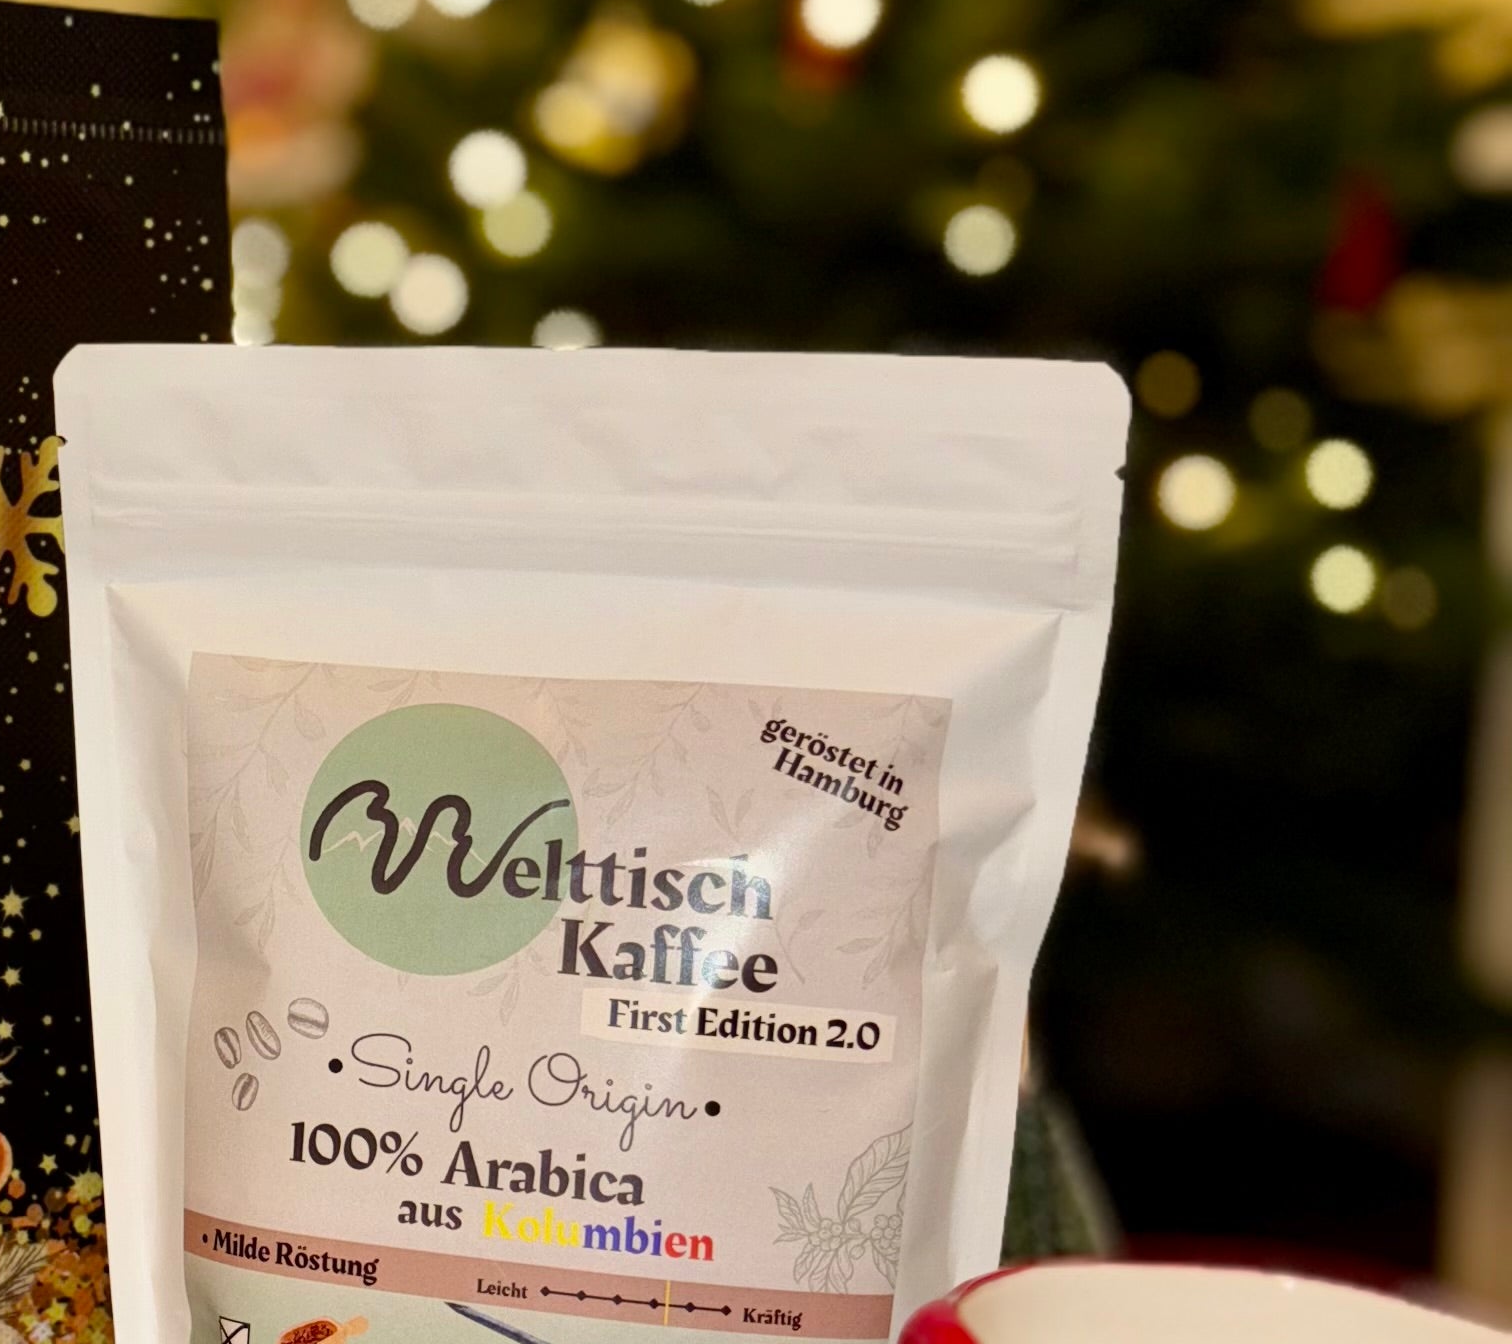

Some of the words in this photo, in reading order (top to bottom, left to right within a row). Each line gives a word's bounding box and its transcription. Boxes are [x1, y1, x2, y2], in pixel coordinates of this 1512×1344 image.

[760, 719, 879, 780] geröstet
[878, 765, 903, 795] in
[772, 746, 910, 831] Hamburg
[309, 778, 773, 921] Welttisch
[558, 918, 779, 993] Kaffee
[607, 998, 687, 1034] First
[696, 1006, 817, 1046] Edition
[825, 1019, 880, 1050] 2.0
[351, 1033, 514, 1132] Single
[528, 1052, 697, 1152] Origin
[289, 1121, 423, 1176] 100%
[440, 1140, 644, 1207] Arabica
[212, 1228, 270, 1263] Milde
[275, 1242, 380, 1286] Röstung
[397, 1200, 463, 1230] aus
[482, 1200, 714, 1261] Kolumbien
[476, 1278, 528, 1299] Leicht
[742, 1306, 803, 1331] Kräftig
